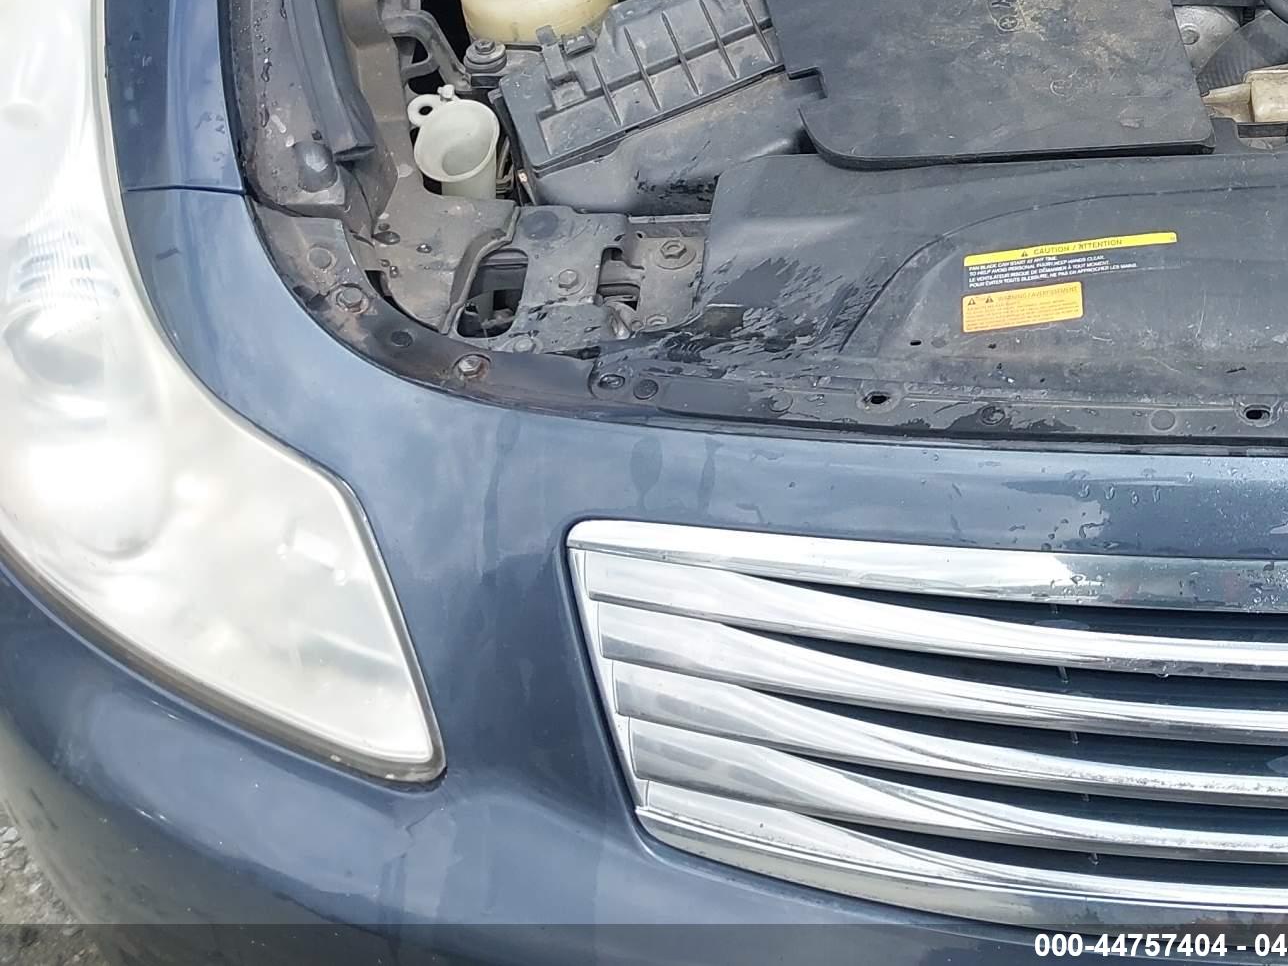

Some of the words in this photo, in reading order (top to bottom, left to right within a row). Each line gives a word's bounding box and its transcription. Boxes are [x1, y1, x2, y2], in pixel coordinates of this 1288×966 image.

[1033, 244, 1069, 255] CAUTION
[1078, 238, 1123, 251] ATTENTION
[968, 264, 979, 272] FAN
